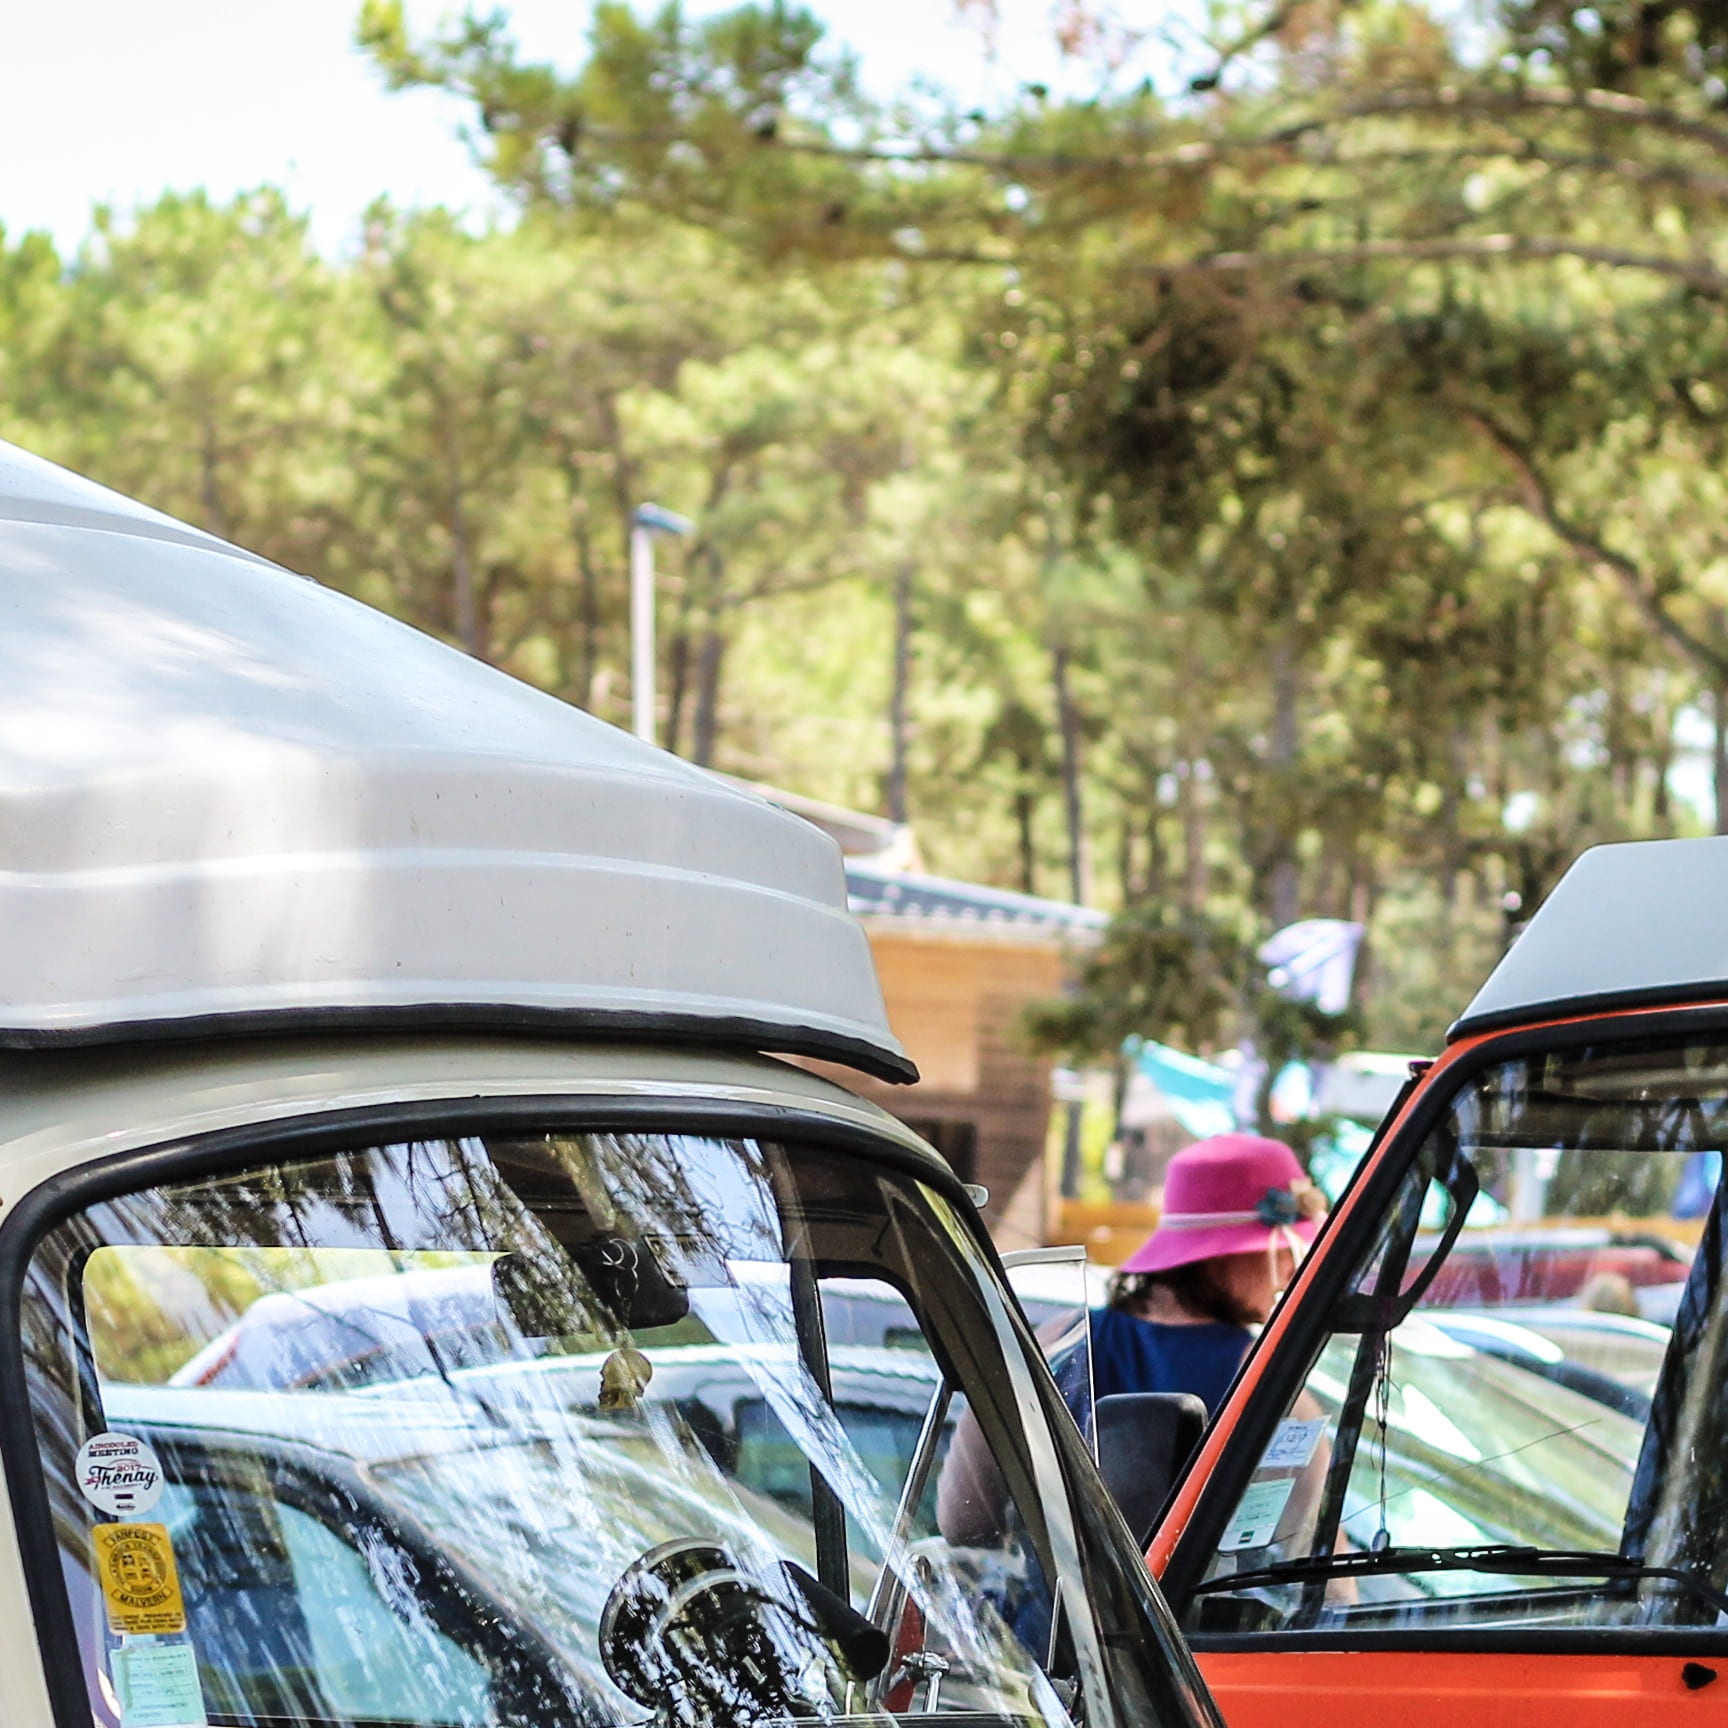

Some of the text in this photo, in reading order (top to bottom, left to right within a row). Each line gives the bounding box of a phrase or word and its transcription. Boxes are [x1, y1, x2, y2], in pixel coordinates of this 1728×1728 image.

[89, 1441, 139, 1450] AIRCOOLED
[88, 1448, 138, 1457] MEETING
[117, 1464, 141, 1472] 2017
[89, 1465, 156, 1491] Thenay
[120, 1590, 167, 1607] MALVERN
